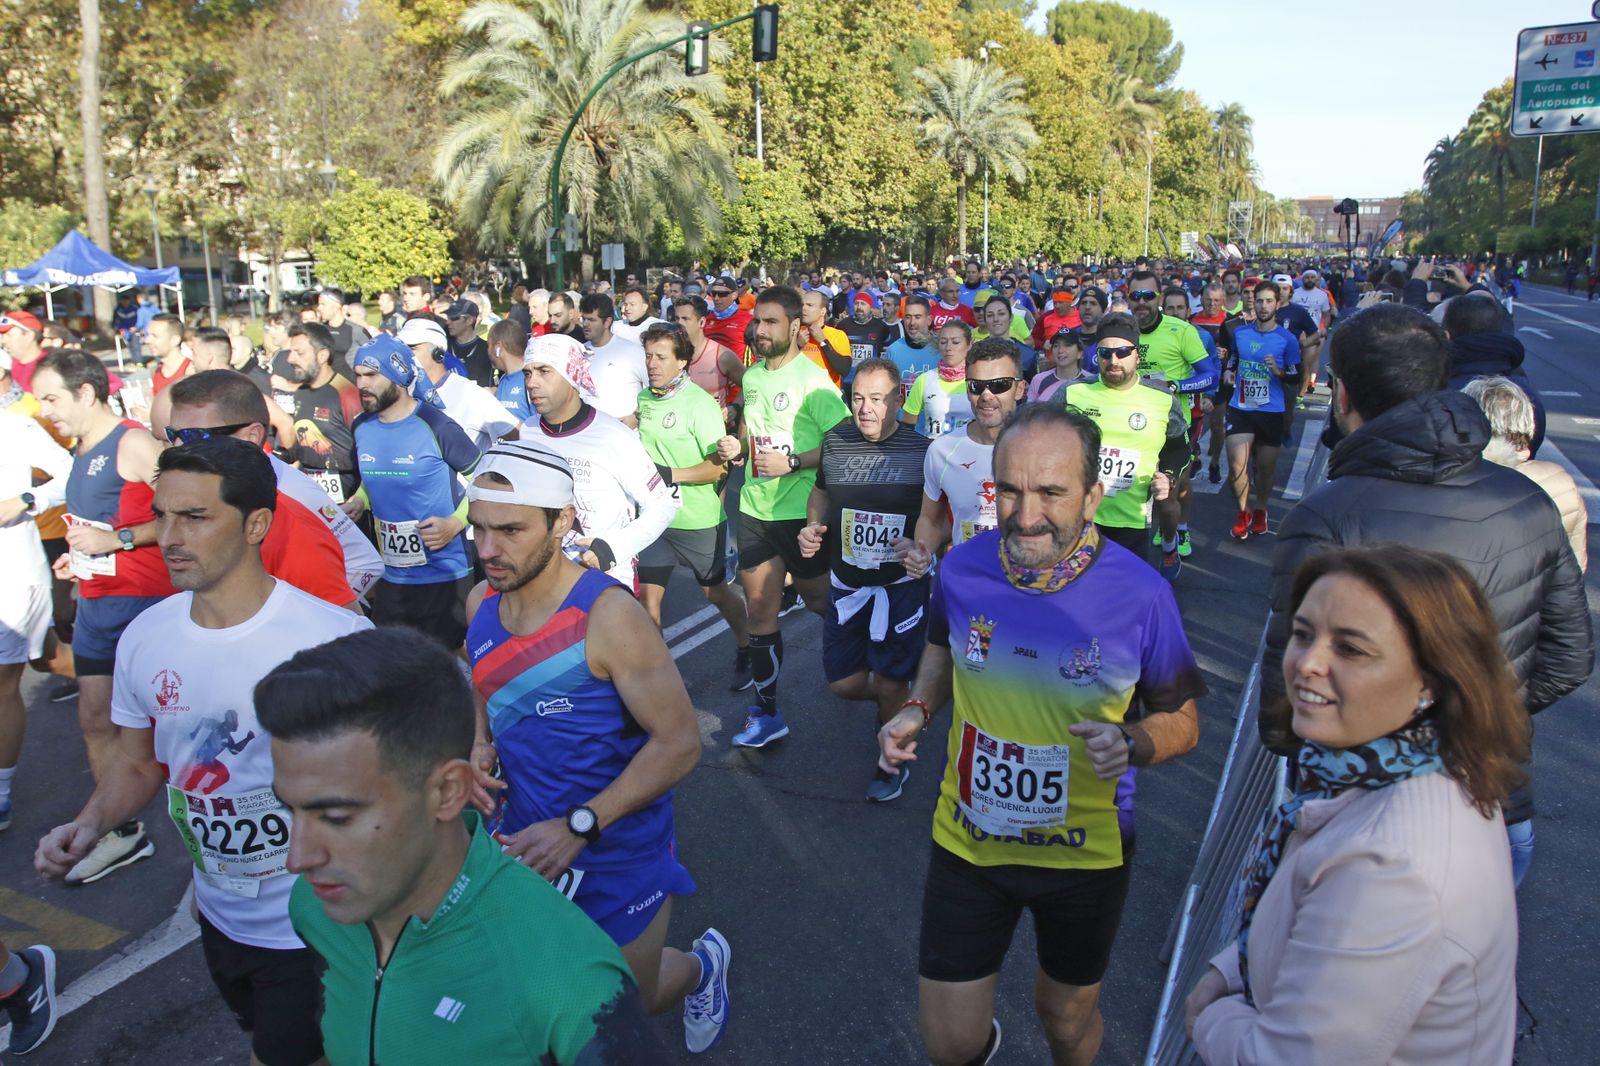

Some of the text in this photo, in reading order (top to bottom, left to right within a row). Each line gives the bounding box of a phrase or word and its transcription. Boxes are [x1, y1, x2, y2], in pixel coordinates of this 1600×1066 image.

[1547, 33, 1585, 45] N-437
[1533, 81, 1590, 94] Avda. del
[1528, 96, 1595, 109] Aeropuerto
[853, 350, 872, 358] 1218
[1245, 386, 1268, 397] 3973
[565, 457, 590, 468] EDIA
[839, 468, 903, 482] SMITH
[854, 524, 900, 547] 8043
[381, 533, 420, 553] 7428
[975, 755, 1063, 805] 3305
[996, 800, 1031, 813] CUENCA
[192, 813, 289, 855] 2229
[627, 890, 663, 914] Joma
